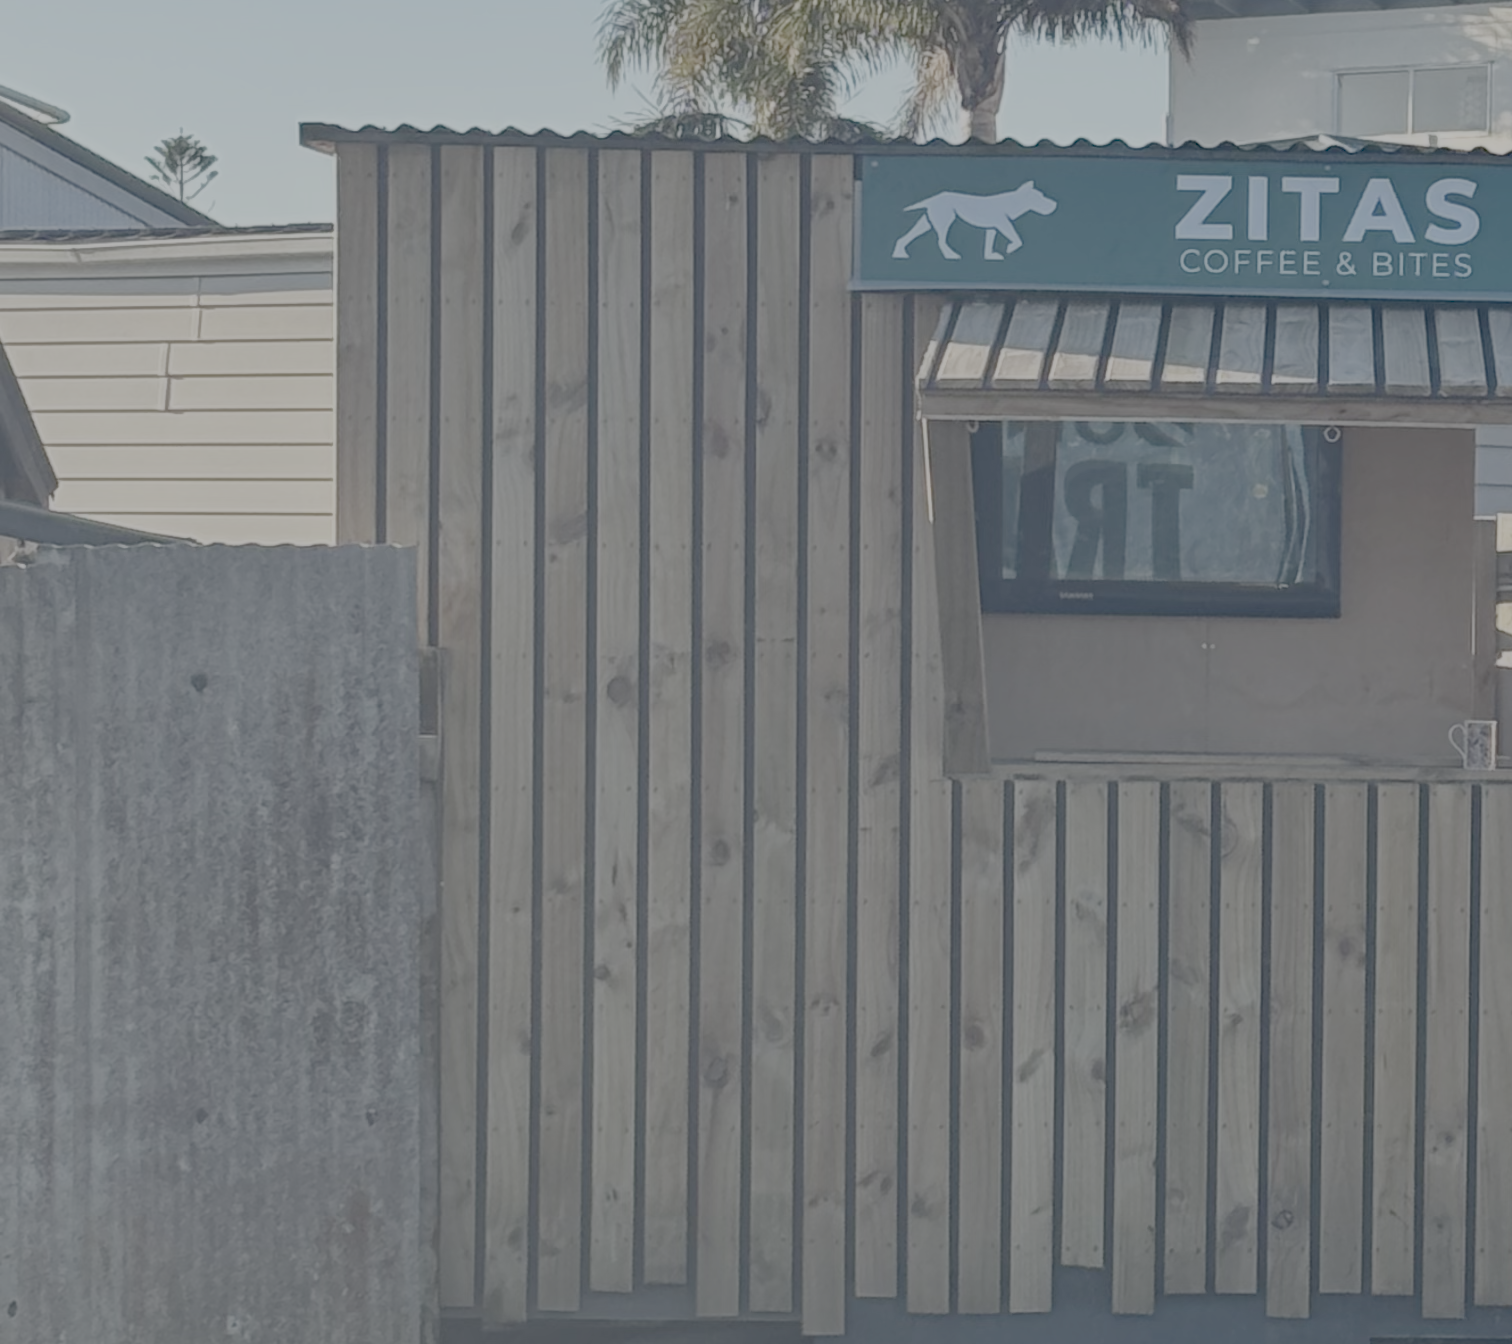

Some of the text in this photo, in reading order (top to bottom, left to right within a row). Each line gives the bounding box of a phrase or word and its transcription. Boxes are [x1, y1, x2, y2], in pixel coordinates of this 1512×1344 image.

[1175, 174, 1480, 245] ZITAS
[1179, 248, 1472, 277] COFFEE & BITES
